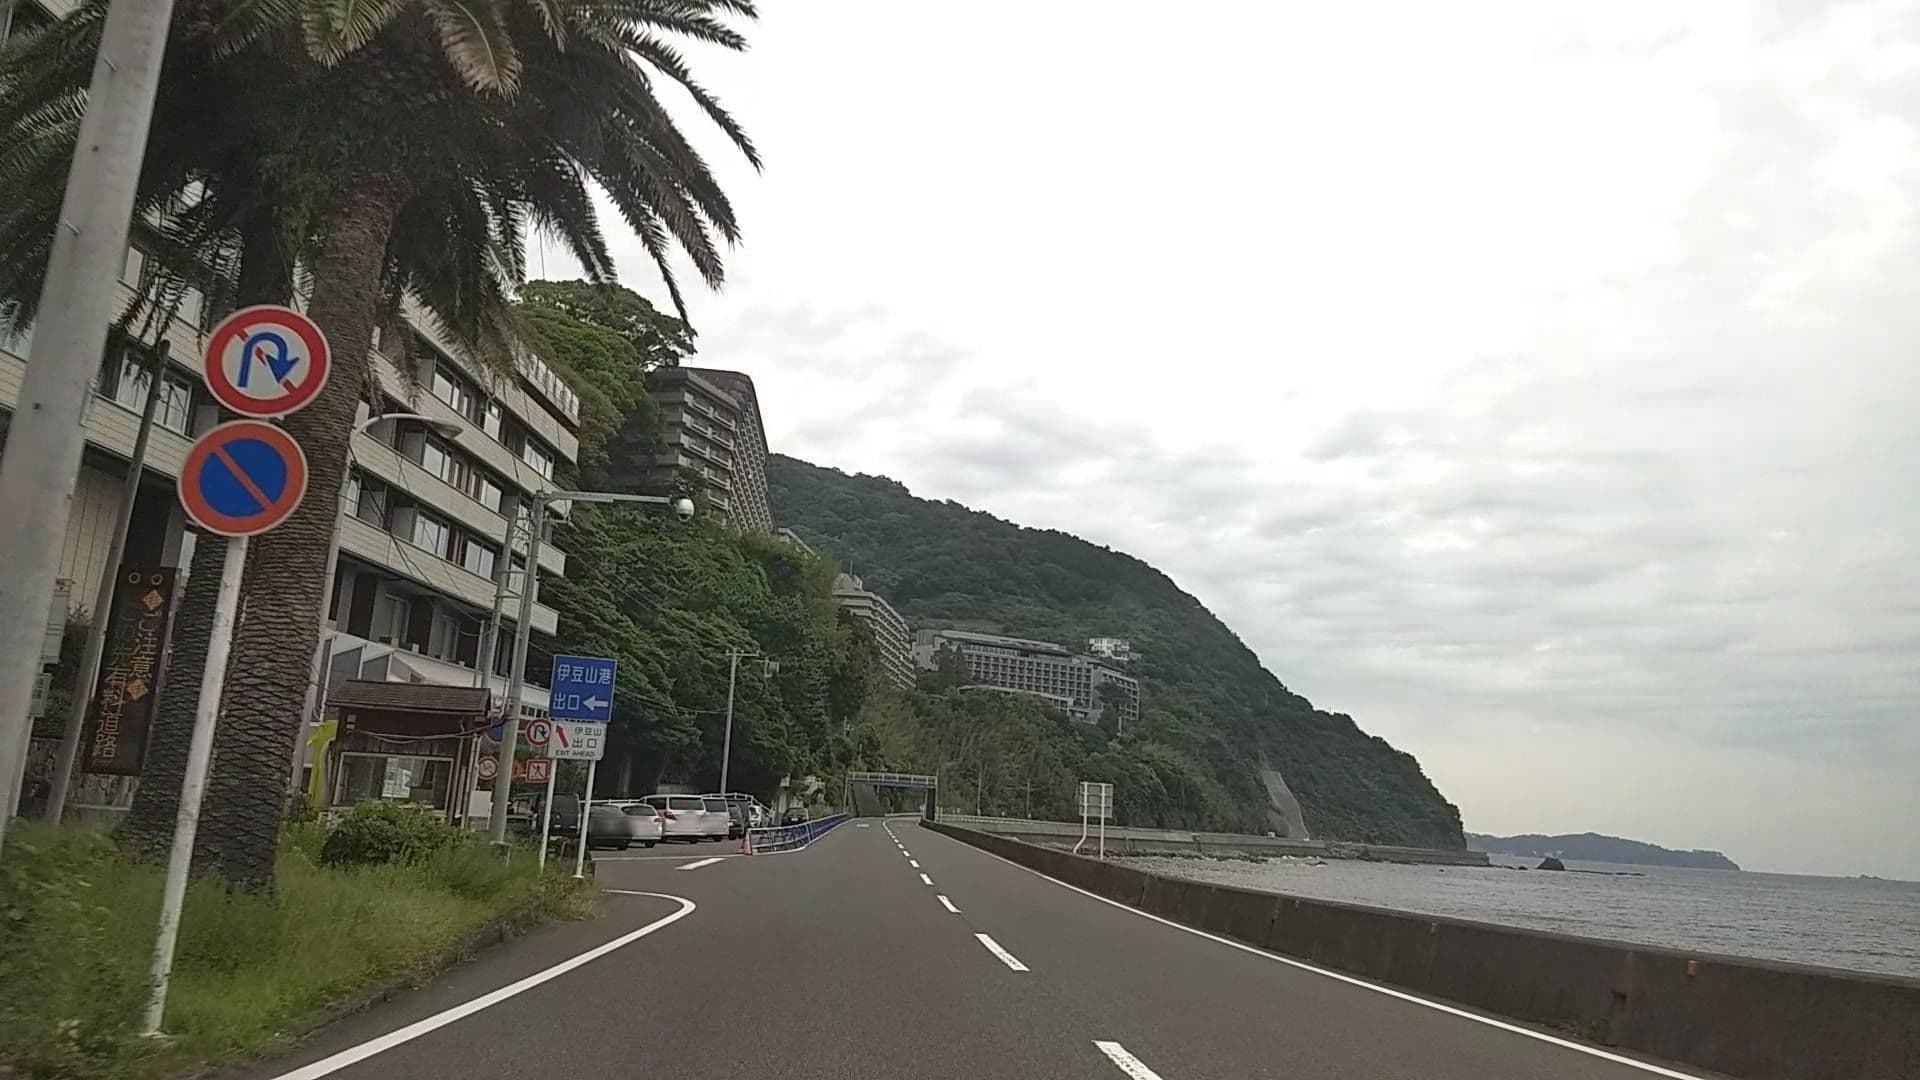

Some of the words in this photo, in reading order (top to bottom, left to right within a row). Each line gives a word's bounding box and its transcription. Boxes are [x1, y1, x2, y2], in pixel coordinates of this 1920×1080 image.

[557, 664, 612, 685] 伊豆山港
[552, 692, 580, 711] 出口
[574, 726, 602, 737] 伊豆山
[572, 737, 598, 748] 出口
[555, 749, 570, 757] EXIT
[572, 749, 595, 758] AHEAD
